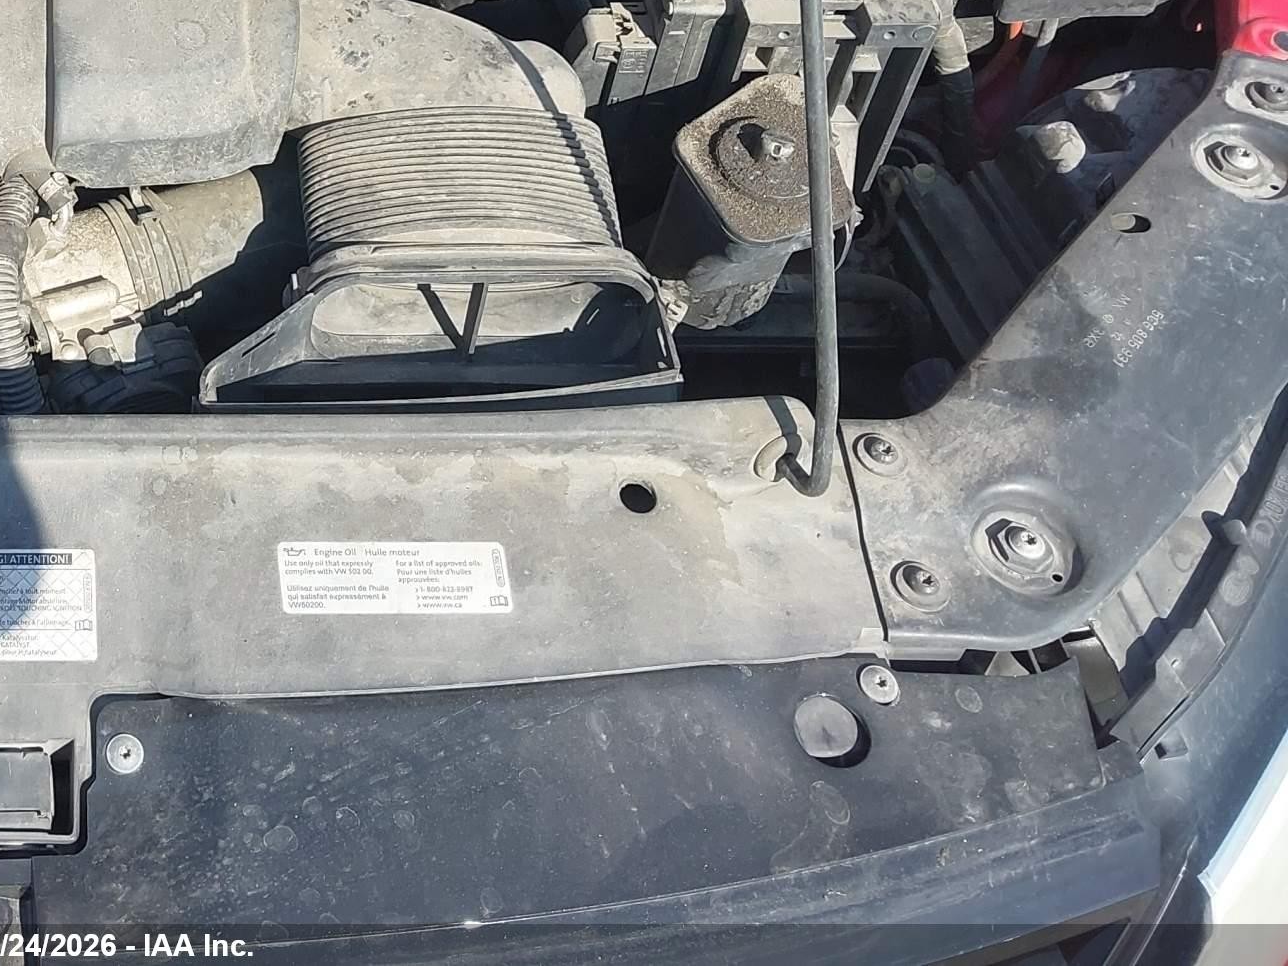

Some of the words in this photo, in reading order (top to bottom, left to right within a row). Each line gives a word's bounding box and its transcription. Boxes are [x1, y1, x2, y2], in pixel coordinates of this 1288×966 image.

[1127, 328, 1148, 349] 805
[1112, 346, 1134, 368] 931
[314, 548, 343, 558] Engine
[344, 548, 357, 556] Oil
[365, 548, 387, 556] Huile
[9, 554, 69, 564] ATTENTION!
[299, 560, 314, 568] only
[285, 568, 316, 576] complies
[314, 585, 356, 593] uniquement
